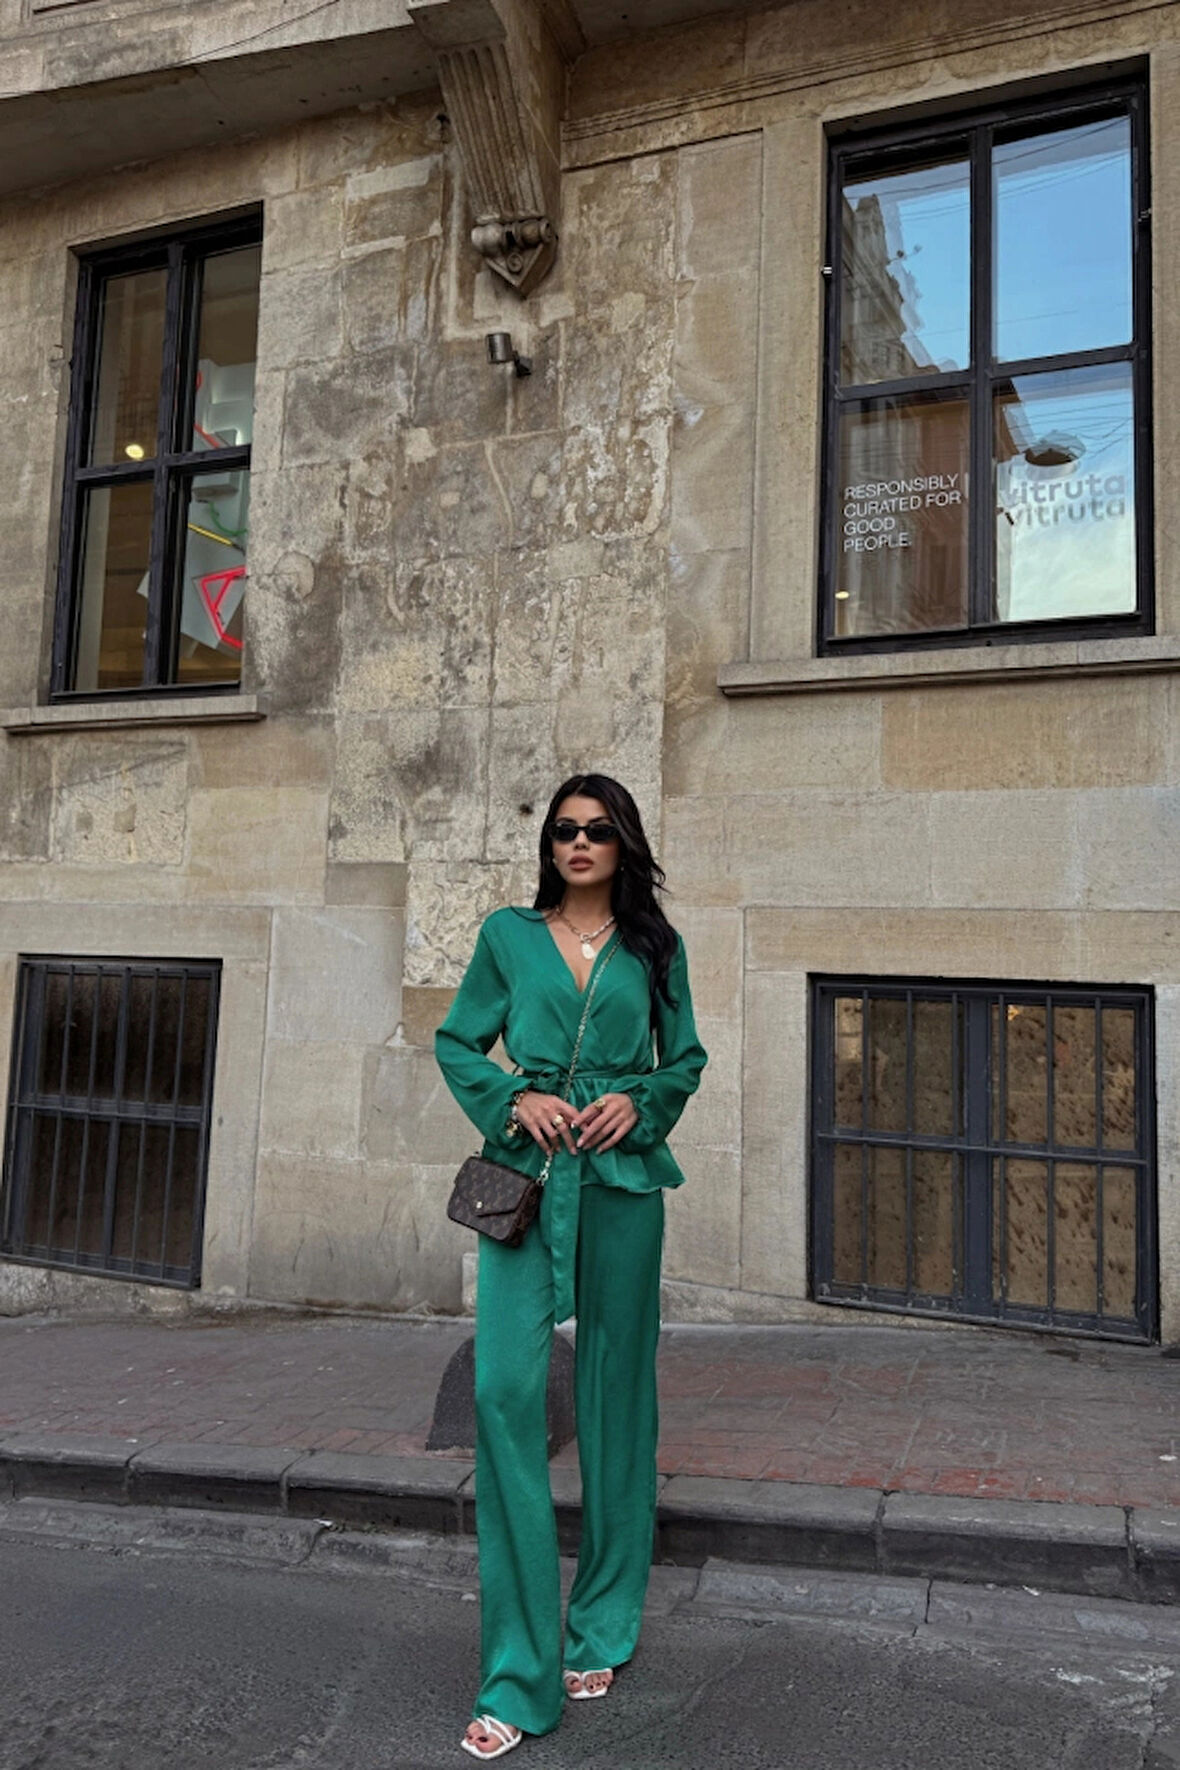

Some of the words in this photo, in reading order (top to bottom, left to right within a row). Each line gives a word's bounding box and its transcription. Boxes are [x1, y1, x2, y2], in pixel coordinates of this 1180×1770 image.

[844, 473, 959, 500] RESPONSIBLY
[1003, 474, 1125, 504] vitruta
[844, 495, 921, 518] CURATED
[925, 490, 962, 507] FOR
[844, 517, 896, 536] GOOD
